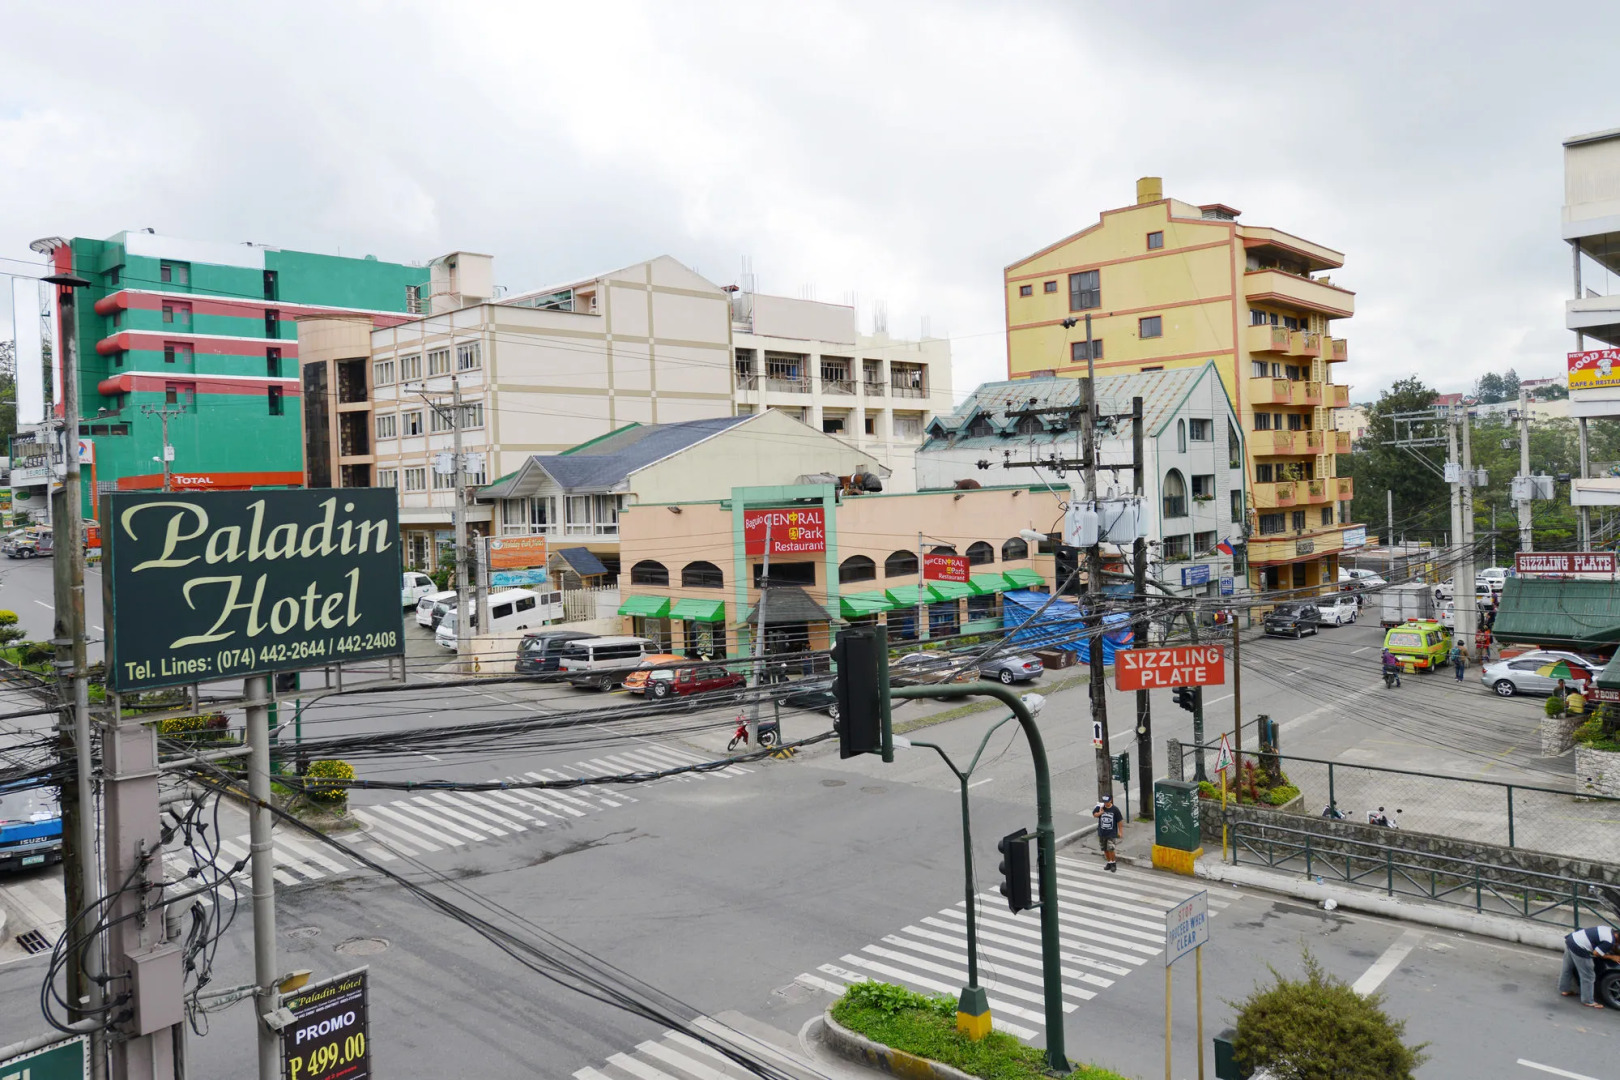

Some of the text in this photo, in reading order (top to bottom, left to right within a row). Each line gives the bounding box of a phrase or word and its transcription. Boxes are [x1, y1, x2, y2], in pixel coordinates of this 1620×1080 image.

[1570, 352, 1599, 374] GOOD
[175, 476, 213, 485] TOTAL
[745, 515, 763, 529] Baguio
[120, 497, 392, 573] Paladin
[798, 527, 823, 539] Park
[775, 541, 824, 552] Restaurant
[951, 567, 965, 575] Park
[1520, 556, 1611, 571] SIZZLING PLATE
[169, 567, 362, 649] Hotel
[126, 631, 397, 681] Tel. Lines: (074) 442-2644 / 442-2408
[1123, 648, 1219, 670] SIZZLING
[1141, 667, 1207, 686] PLATE
[20, 836, 48, 845] ISUZU
[1178, 904, 1192, 921] STOP
[1190, 913, 1204, 928] WHEN
[1176, 931, 1196, 951] CLEAR
[299, 986, 336, 1007] Paladin
[338, 977, 362, 993] Hotel
[295, 1011, 356, 1045] PROMO
[289, 1032, 365, 1080] P 499.00
